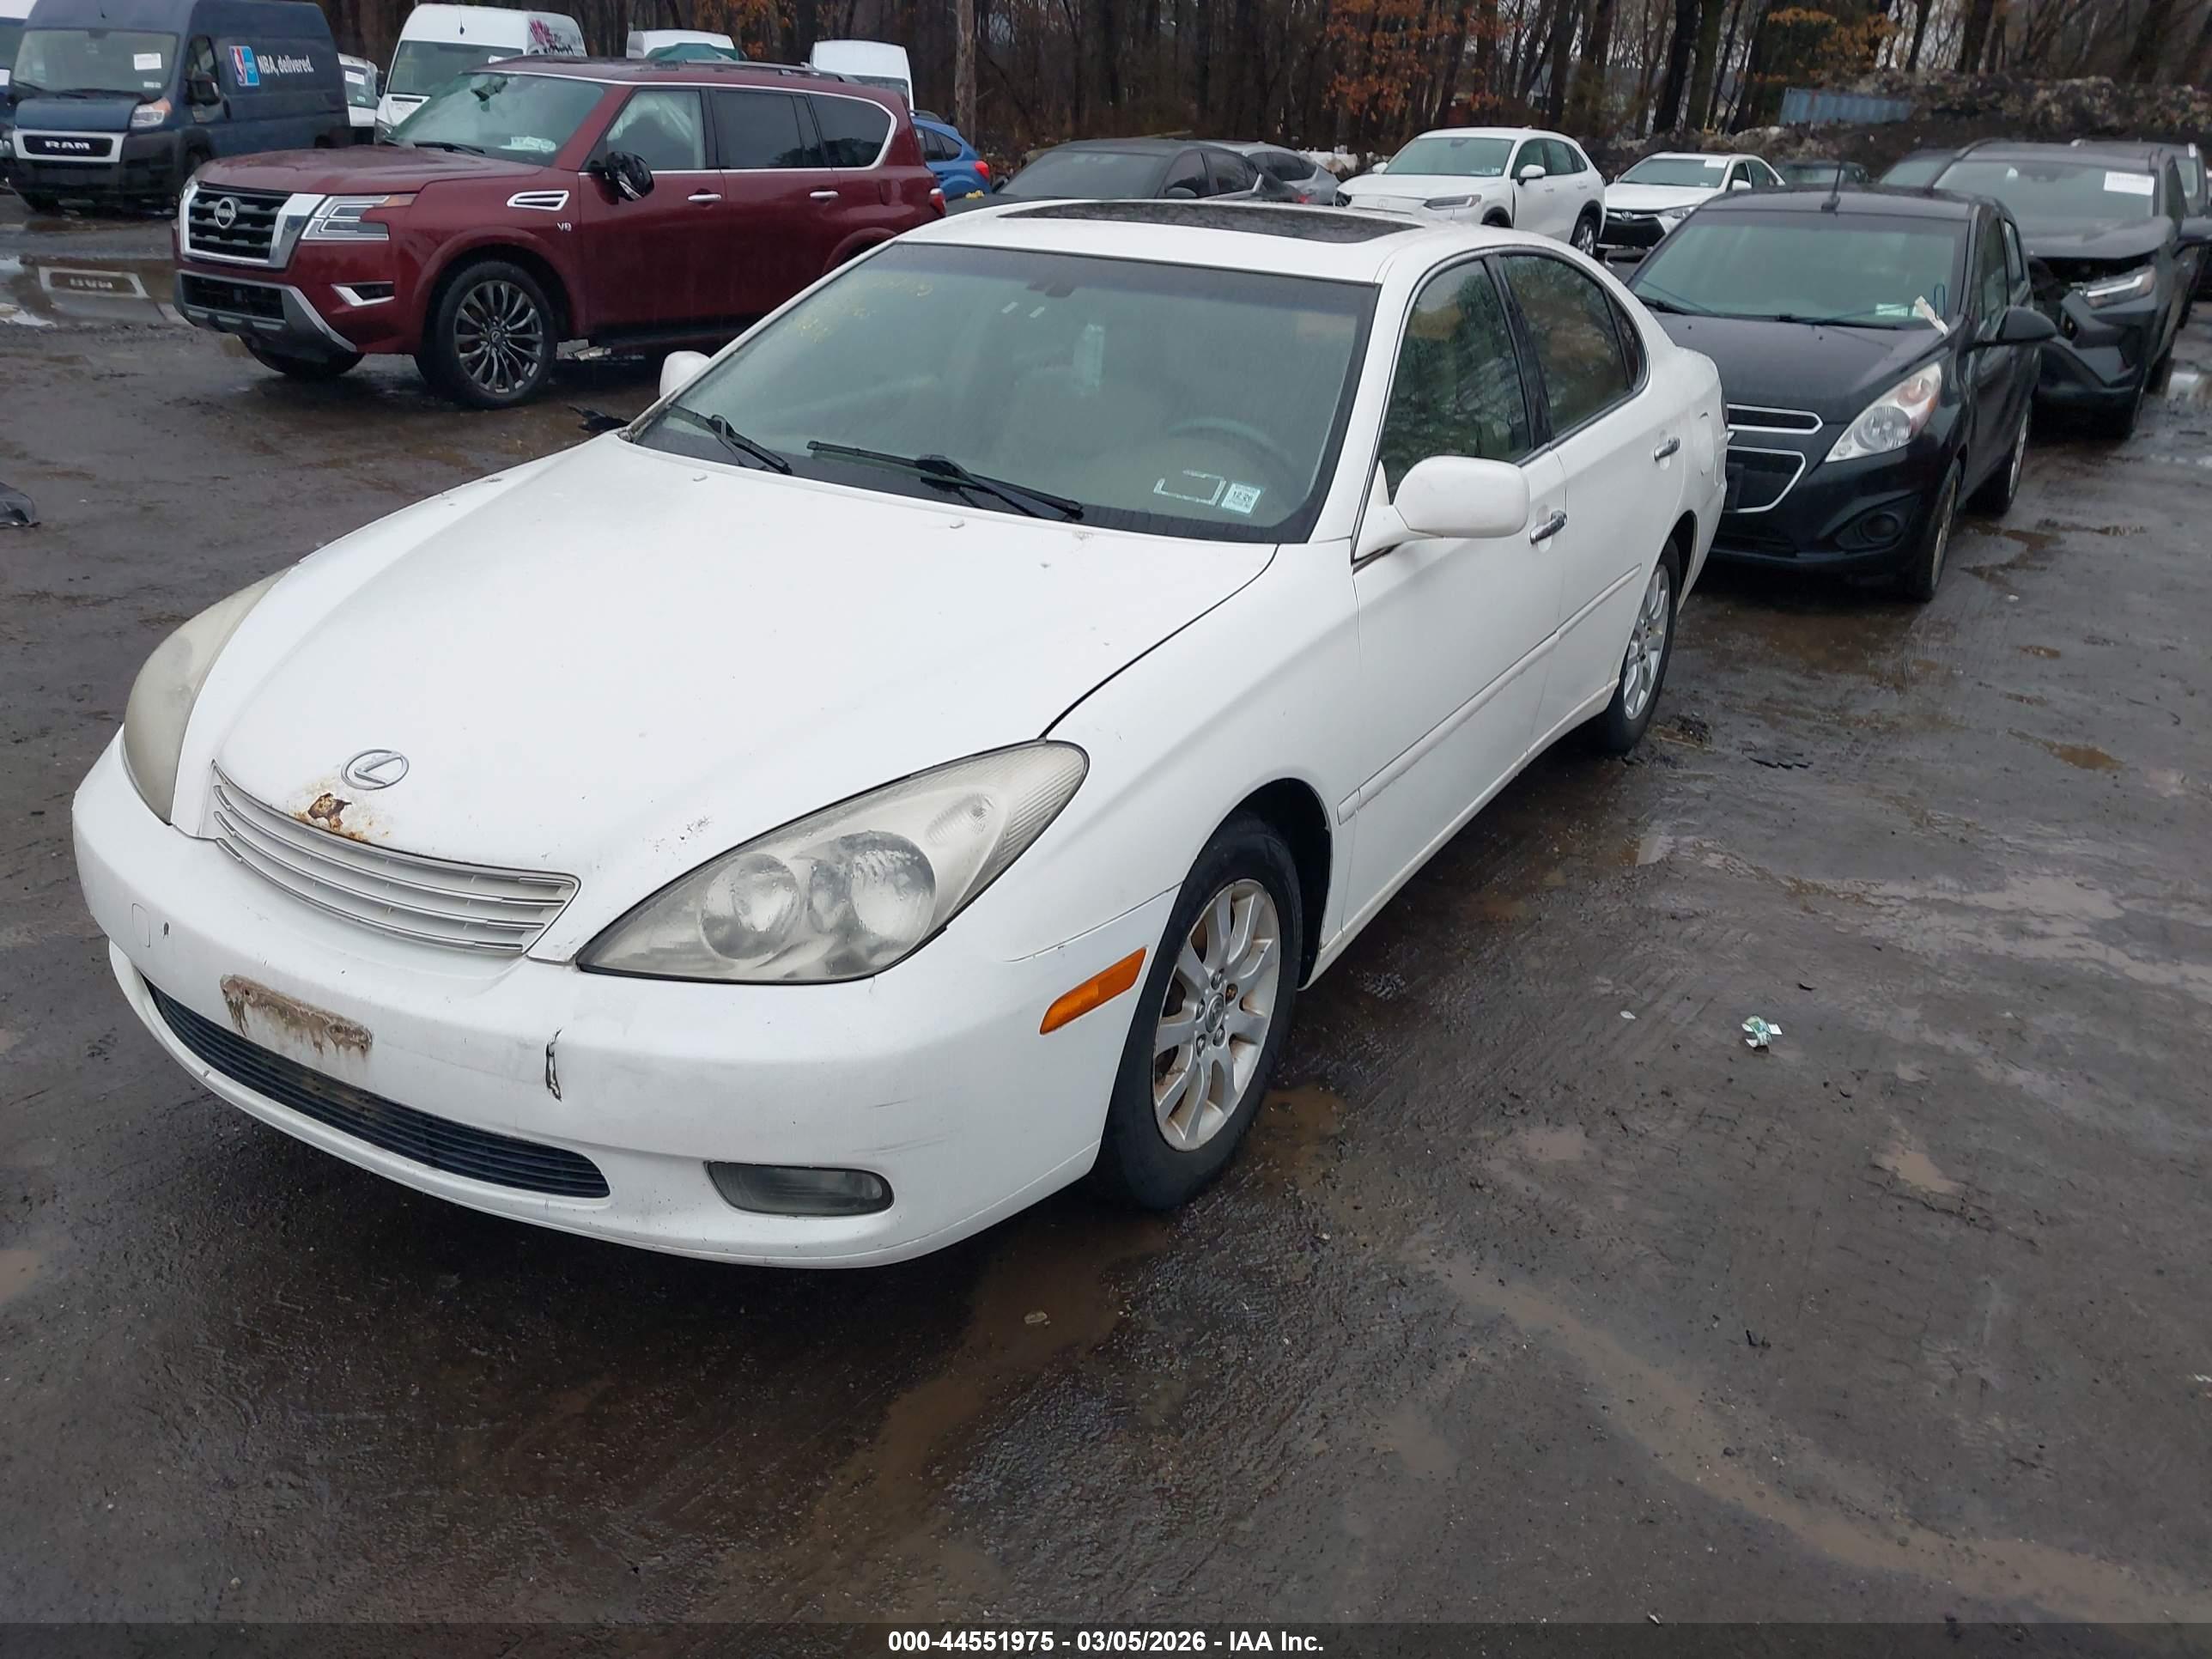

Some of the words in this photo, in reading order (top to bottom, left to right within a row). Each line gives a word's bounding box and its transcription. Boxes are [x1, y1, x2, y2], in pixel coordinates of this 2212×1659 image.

[257, 54, 279, 76] NBA,
[277, 54, 314, 74] delivered.
[45, 140, 90, 149] RAM
